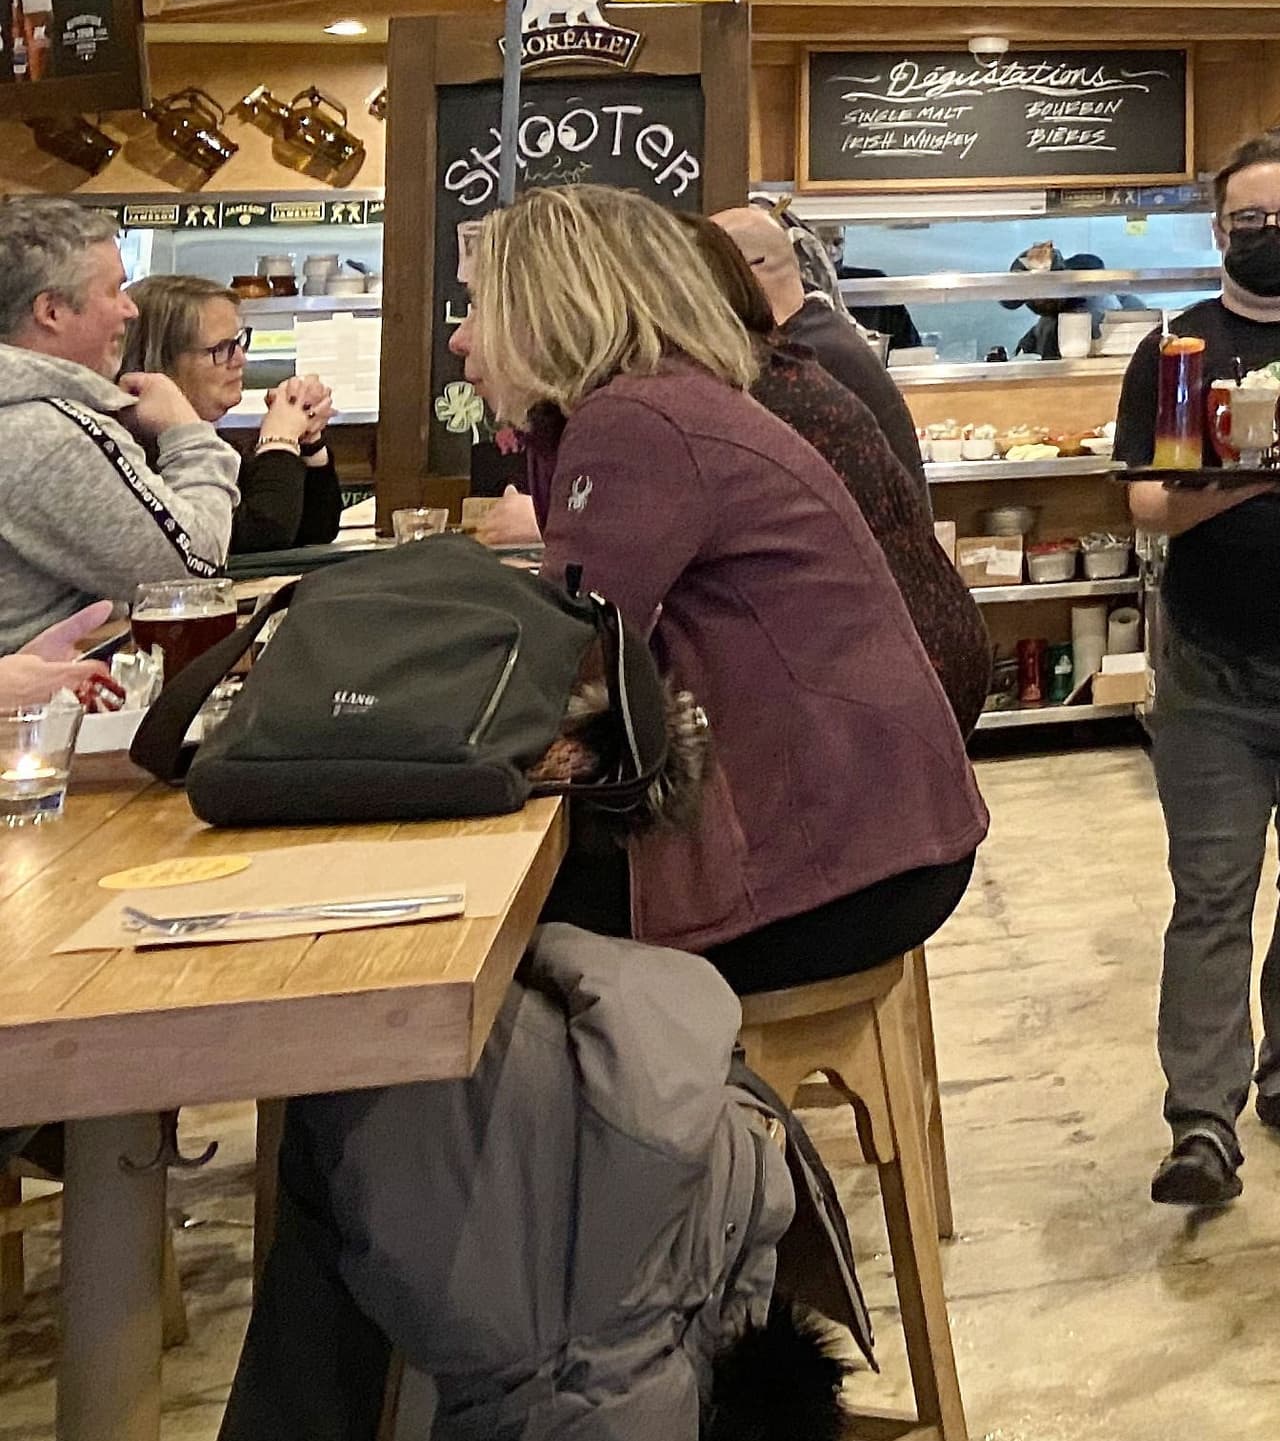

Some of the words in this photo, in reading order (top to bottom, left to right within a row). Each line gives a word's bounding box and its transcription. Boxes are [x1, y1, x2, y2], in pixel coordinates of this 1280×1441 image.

[886, 58, 1115, 100] Dégustations
[840, 107, 914, 126] SINGLE
[916, 105, 974, 121] MALT
[1025, 97, 1124, 120] BOURBON
[841, 131, 898, 153] IRISH
[902, 127, 979, 160] WHISKEY
